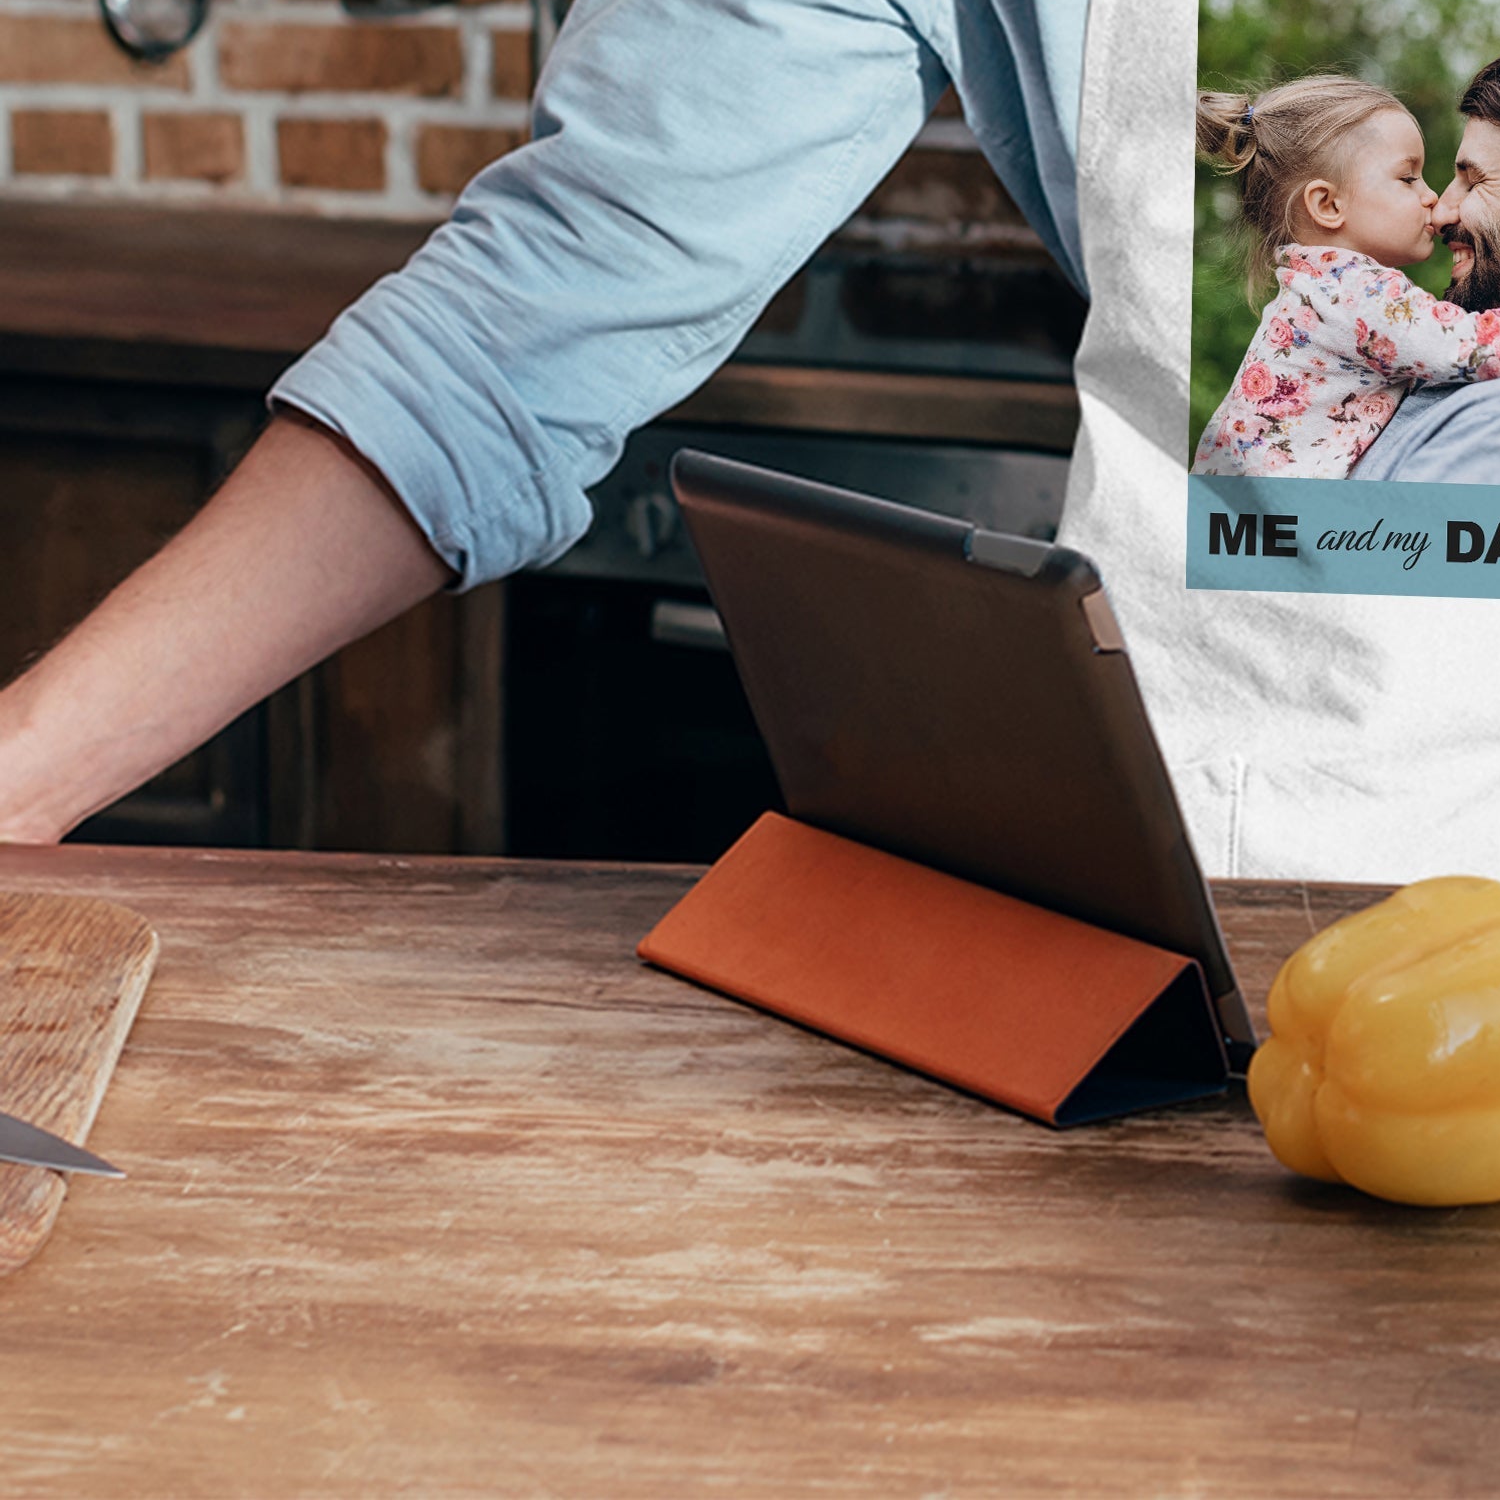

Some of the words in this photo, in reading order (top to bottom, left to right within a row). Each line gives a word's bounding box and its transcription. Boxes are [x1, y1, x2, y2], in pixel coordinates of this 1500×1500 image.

[1208, 512, 1299, 558] ME
[1316, 518, 1380, 552] and
[1382, 530, 1432, 571] my
